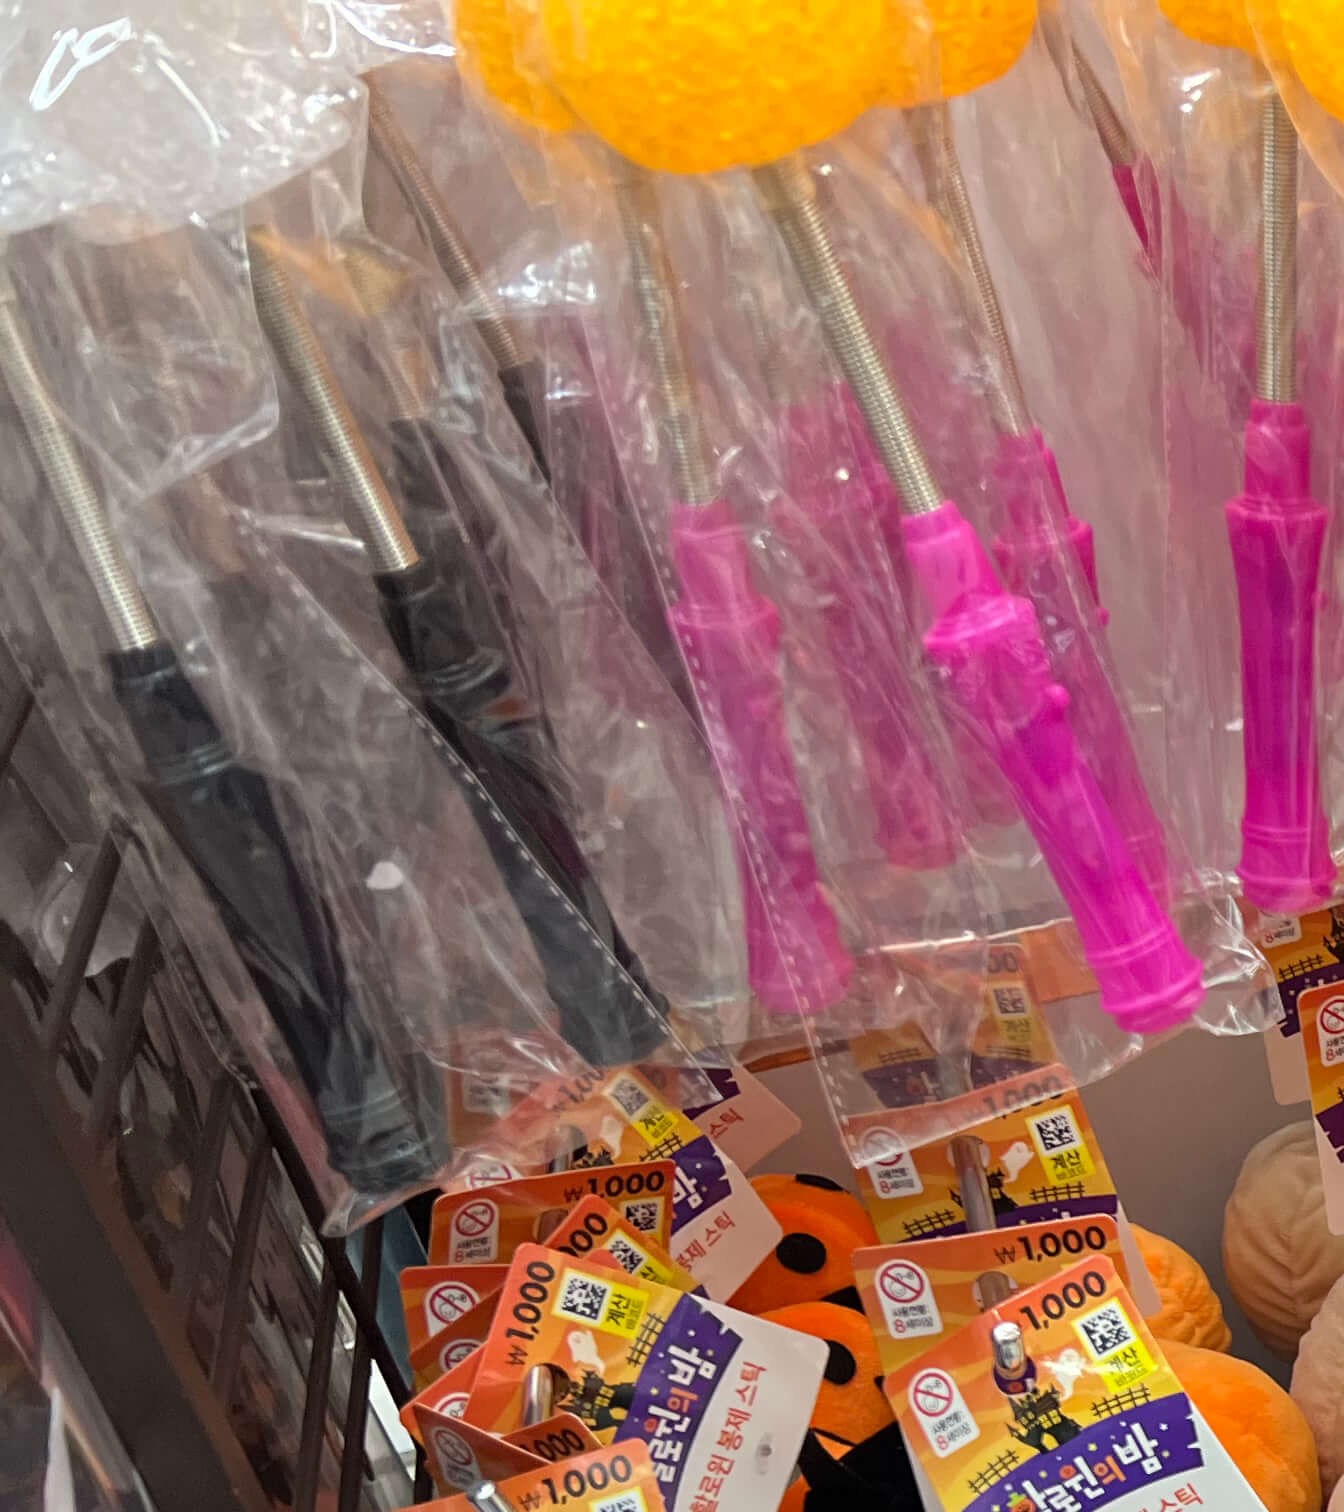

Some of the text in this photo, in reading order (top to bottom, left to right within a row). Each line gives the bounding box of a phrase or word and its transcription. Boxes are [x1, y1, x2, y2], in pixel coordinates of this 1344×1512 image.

[1051, 1151, 1082, 1170] 계산
[704, 1209, 737, 1245] 스틱
[995, 1224, 1107, 1265] ₩1,000
[504, 1260, 557, 1367] ₩1,000
[605, 1293, 632, 1328] 계산
[668, 1341, 718, 1388] 밤
[734, 1360, 768, 1407] 스틱
[716, 1407, 753, 1452] 봉제
[1112, 1421, 1163, 1476] 밤
[517, 1454, 634, 1512] ₩1,000
